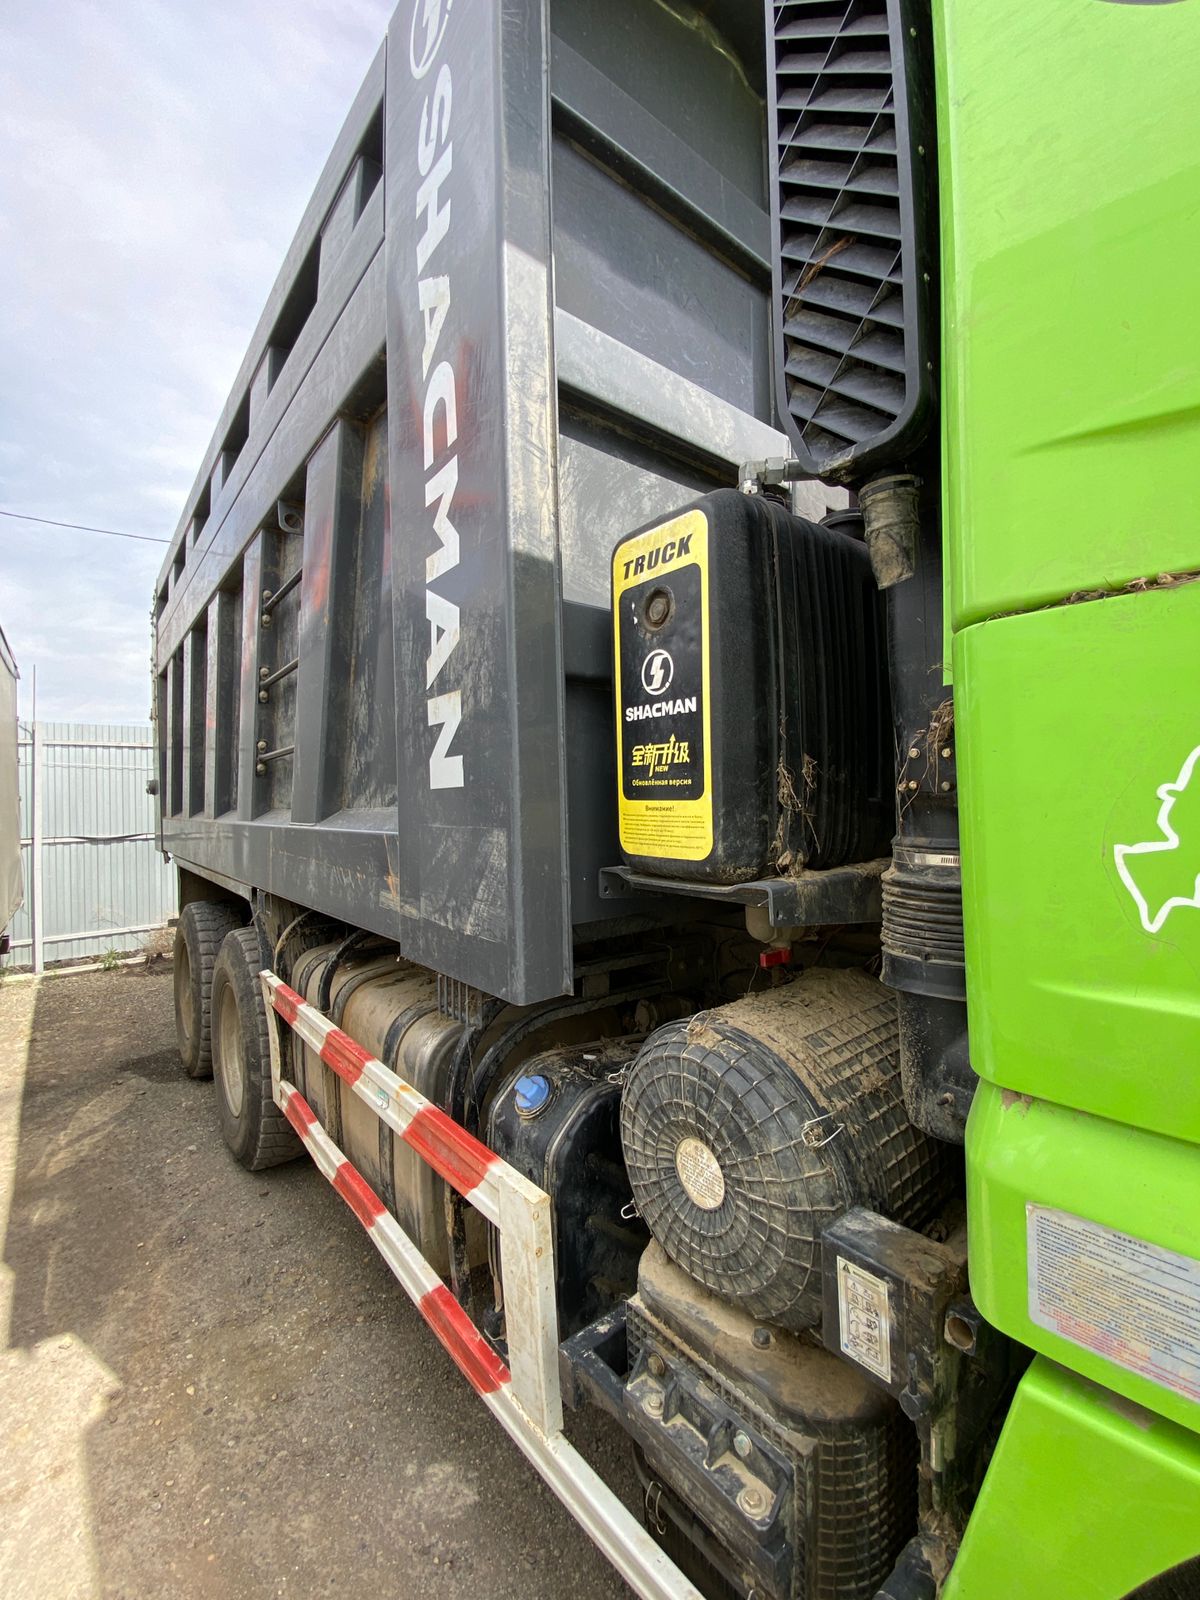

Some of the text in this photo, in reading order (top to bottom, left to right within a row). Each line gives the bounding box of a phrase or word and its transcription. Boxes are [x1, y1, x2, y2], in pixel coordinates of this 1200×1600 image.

[415, 63, 464, 790] SHACMAN
[623, 533, 693, 580] TRUCK
[625, 696, 697, 722] SHACMAN
[631, 733, 690, 777] 全新升级
[669, 779, 692, 787] версия
